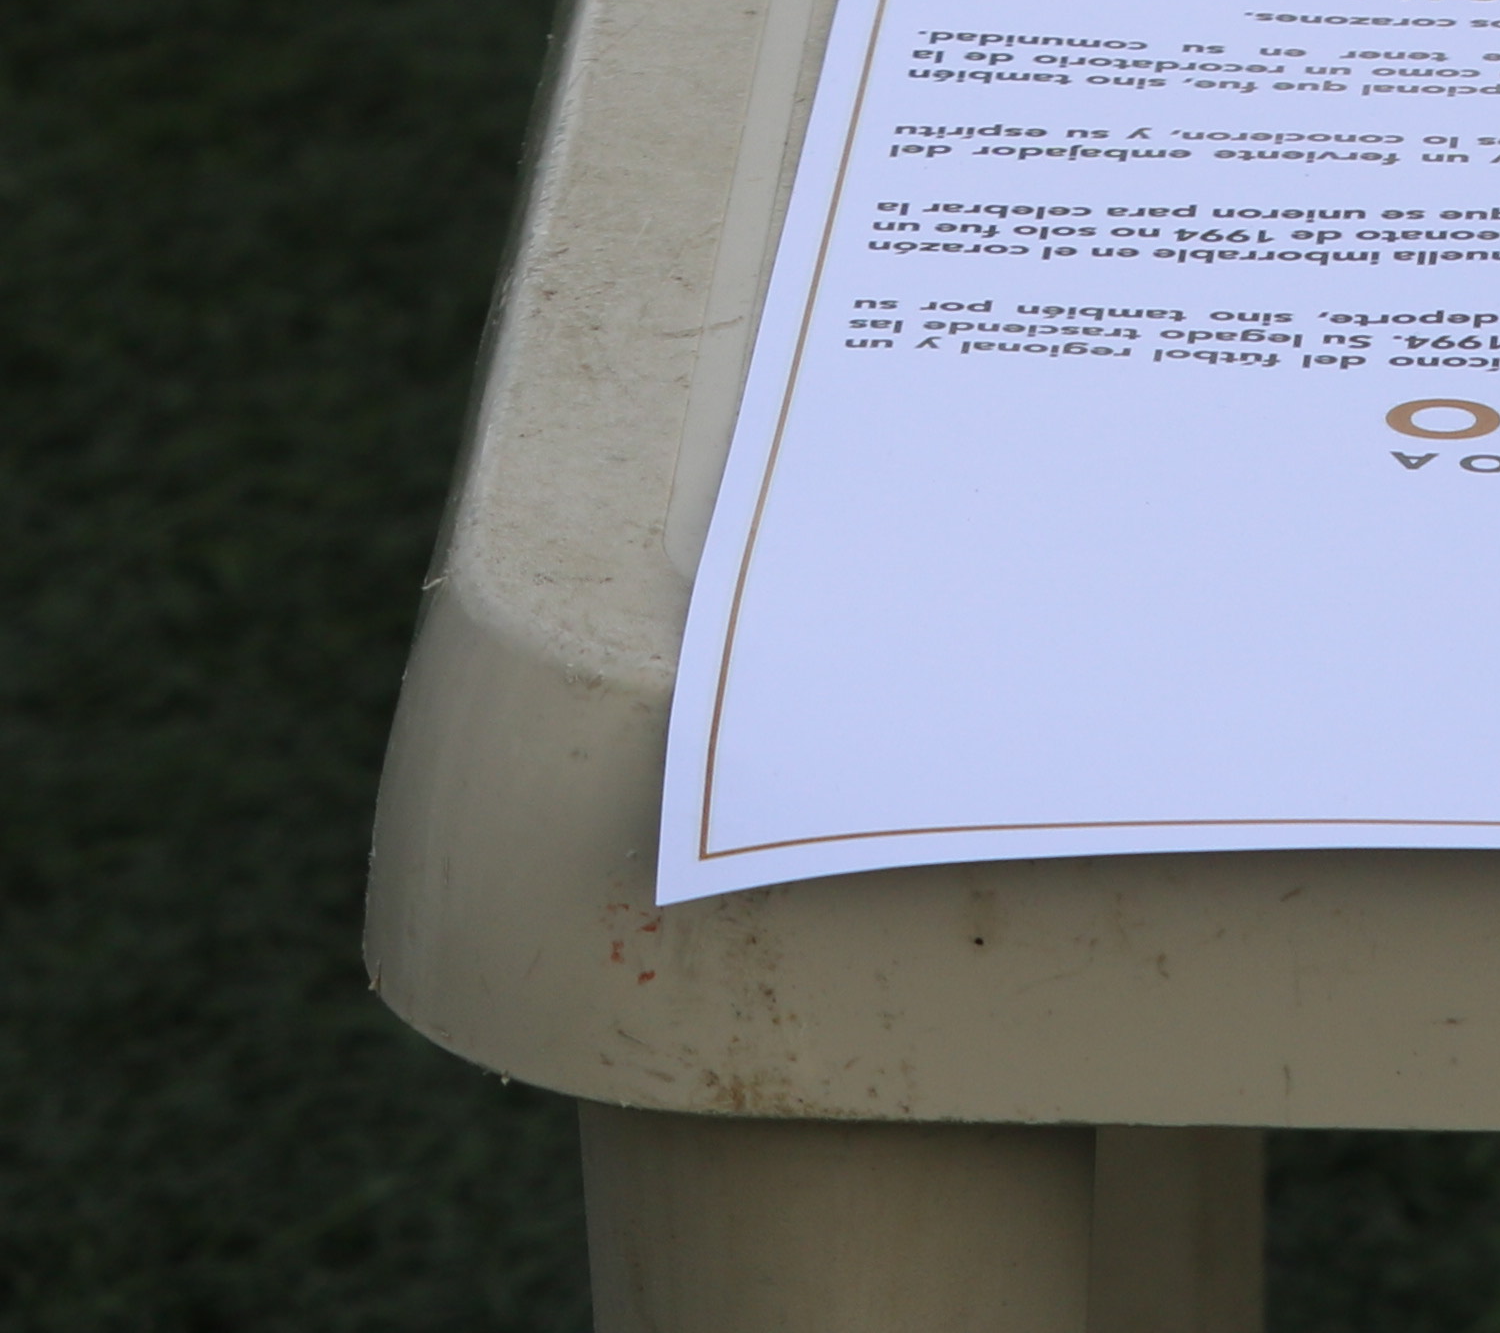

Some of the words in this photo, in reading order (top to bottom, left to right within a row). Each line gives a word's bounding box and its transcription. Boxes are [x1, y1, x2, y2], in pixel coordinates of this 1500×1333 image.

[845, 339, 894, 348] un
[914, 336, 943, 349] y
[960, 341, 1132, 358] regional
[1153, 349, 1281, 367] fútbol
[1302, 354, 1366, 370] del
[1388, 356, 1500, 372] ícono
[1389, 451, 1440, 470] A
